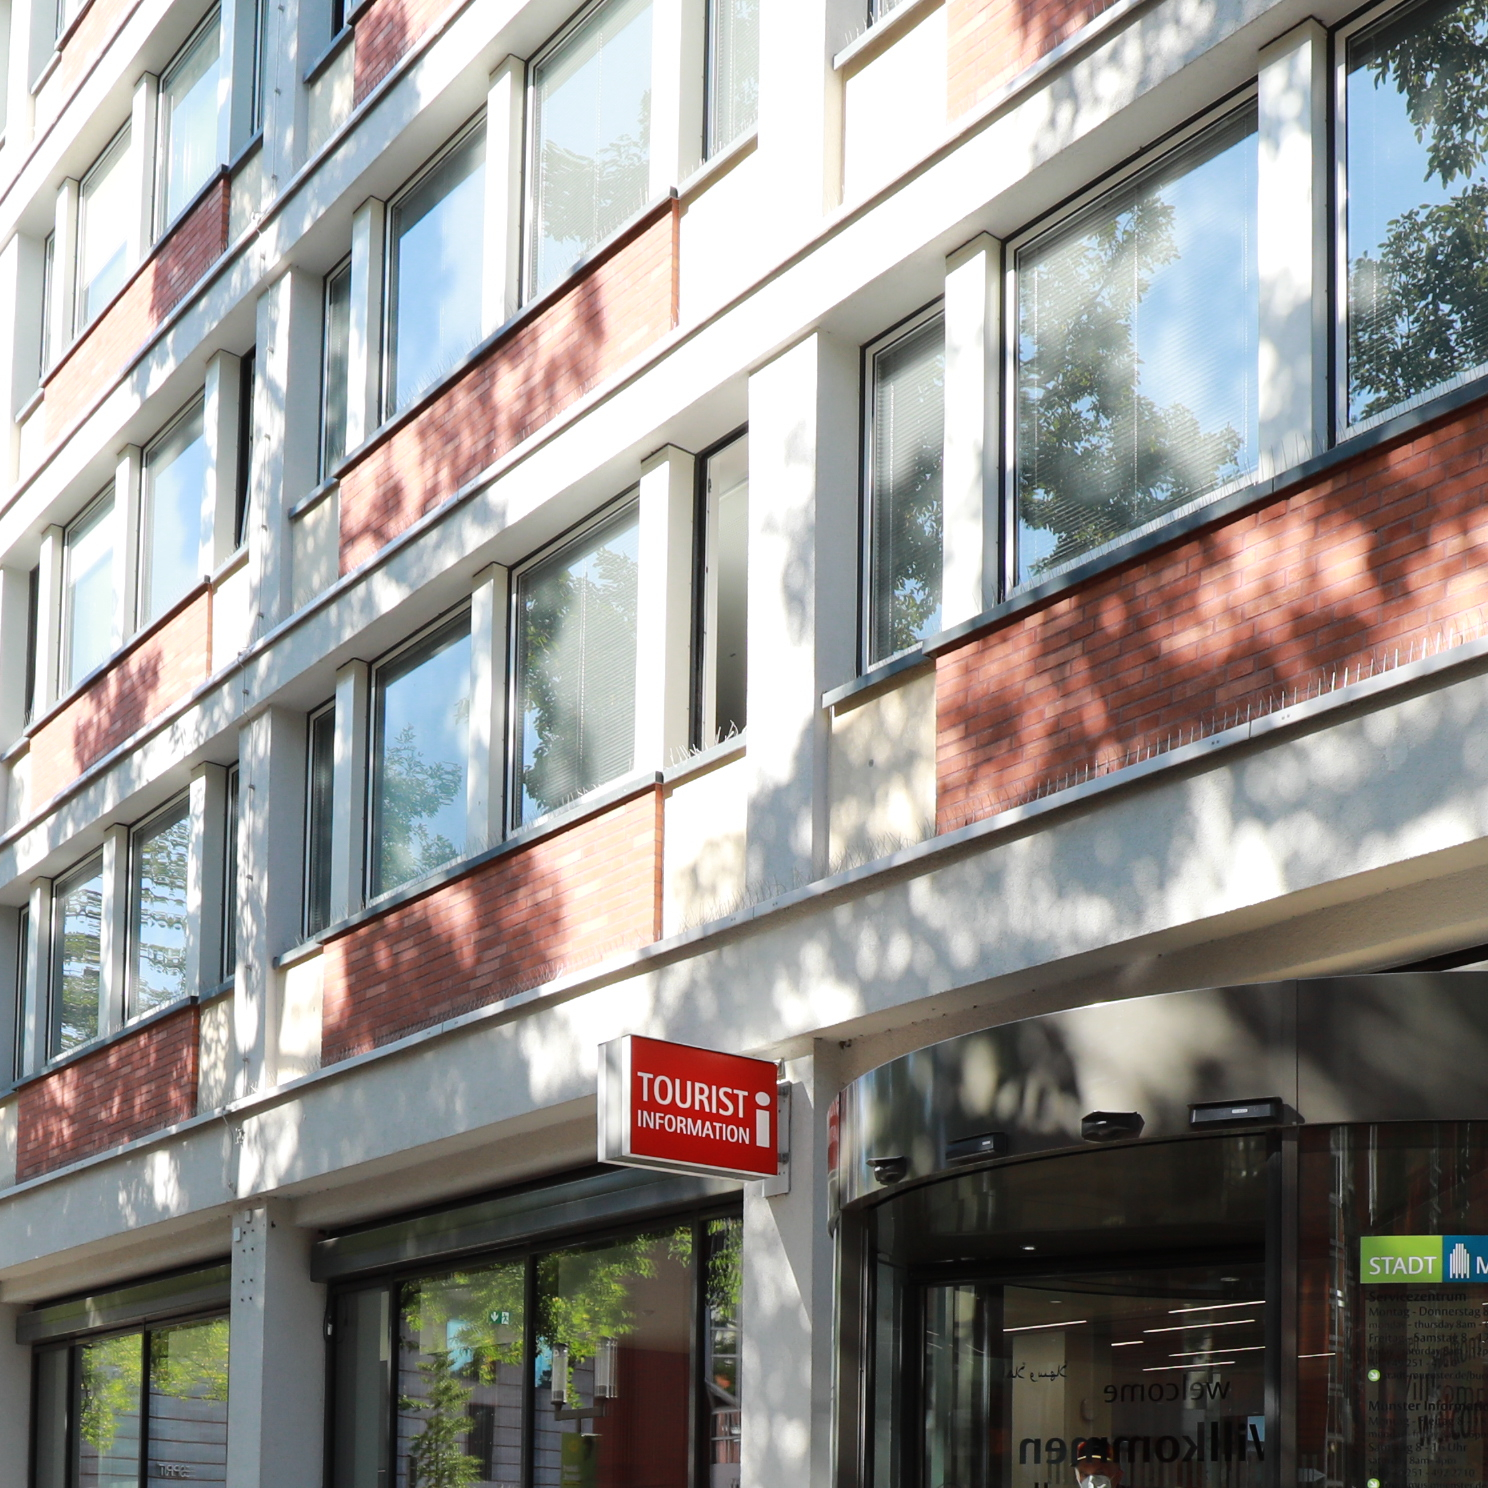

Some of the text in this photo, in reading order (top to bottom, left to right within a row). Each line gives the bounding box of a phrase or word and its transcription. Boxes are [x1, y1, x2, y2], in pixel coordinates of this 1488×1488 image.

[637, 1072, 748, 1118] TOURIST
[637, 1110, 750, 1145] INFORMATION
[1369, 1256, 1437, 1275] STADT
[1368, 1292, 1467, 1302] Servicezentrum
[1368, 1307, 1410, 1318] Montag
[1419, 1306, 1480, 1318] Donnerstag
[1414, 1332, 1459, 1344] Samstag
